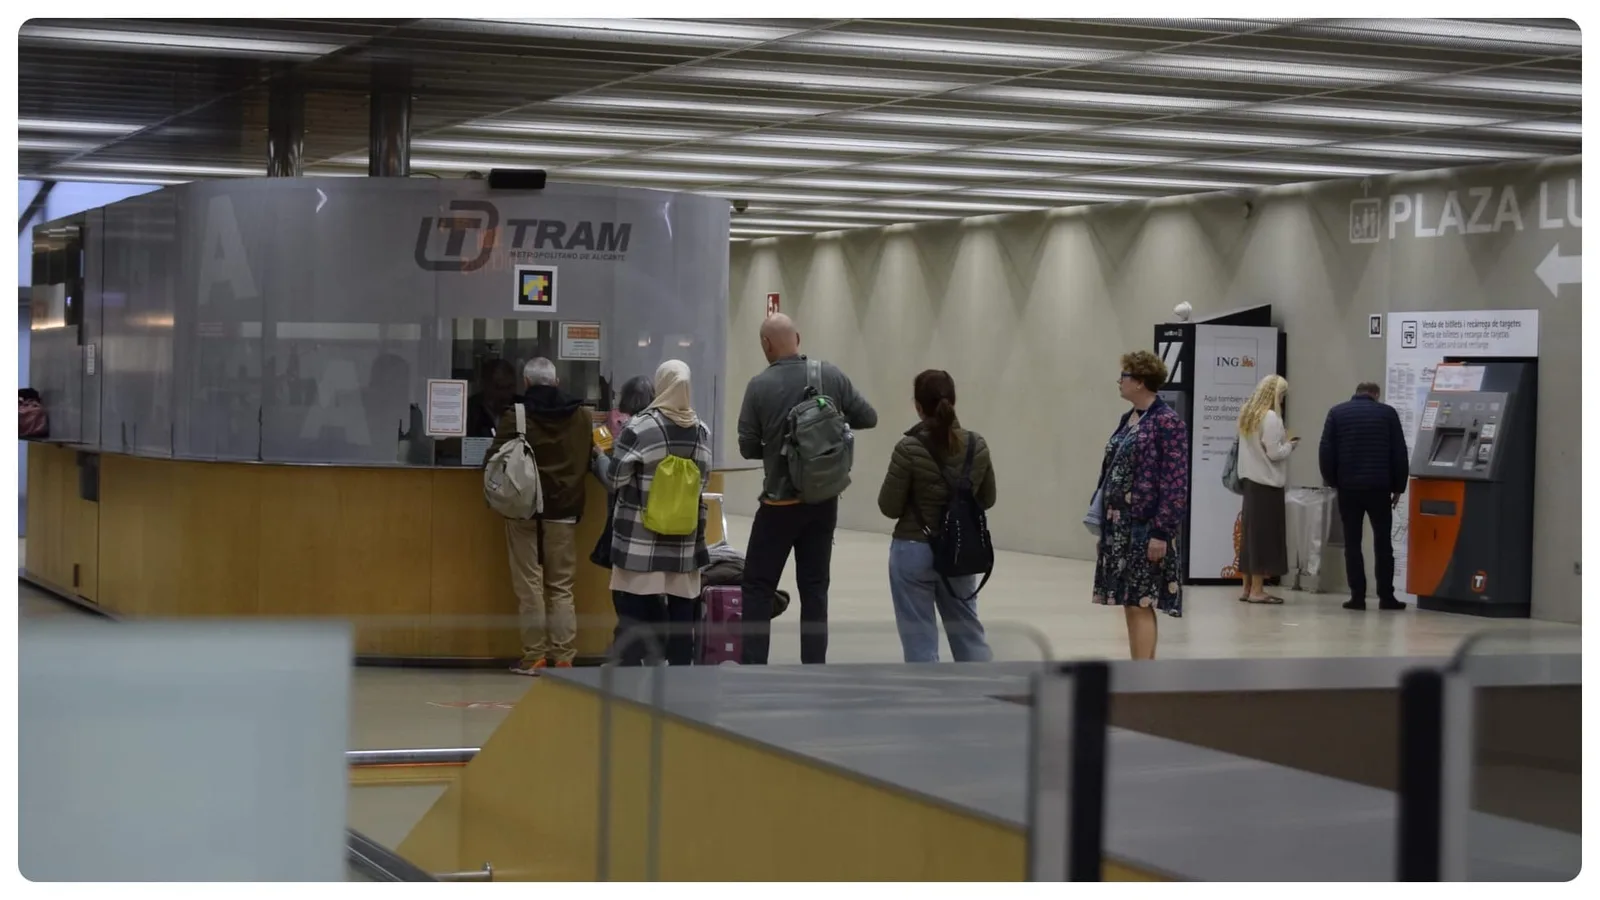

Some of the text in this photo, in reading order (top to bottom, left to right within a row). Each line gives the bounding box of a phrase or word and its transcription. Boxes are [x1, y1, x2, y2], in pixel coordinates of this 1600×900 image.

[1388, 184, 1524, 239] PLAZA
[507, 218, 632, 253] TRAM
[509, 250, 578, 260] METROPOLITANO
[592, 253, 626, 261] ALICANTE
[1422, 320, 1437, 328] Venda
[1438, 320, 1444, 328] de
[1492, 319, 1498, 328] de
[1216, 356, 1239, 367] ING
[1475, 575, 1484, 588] T
